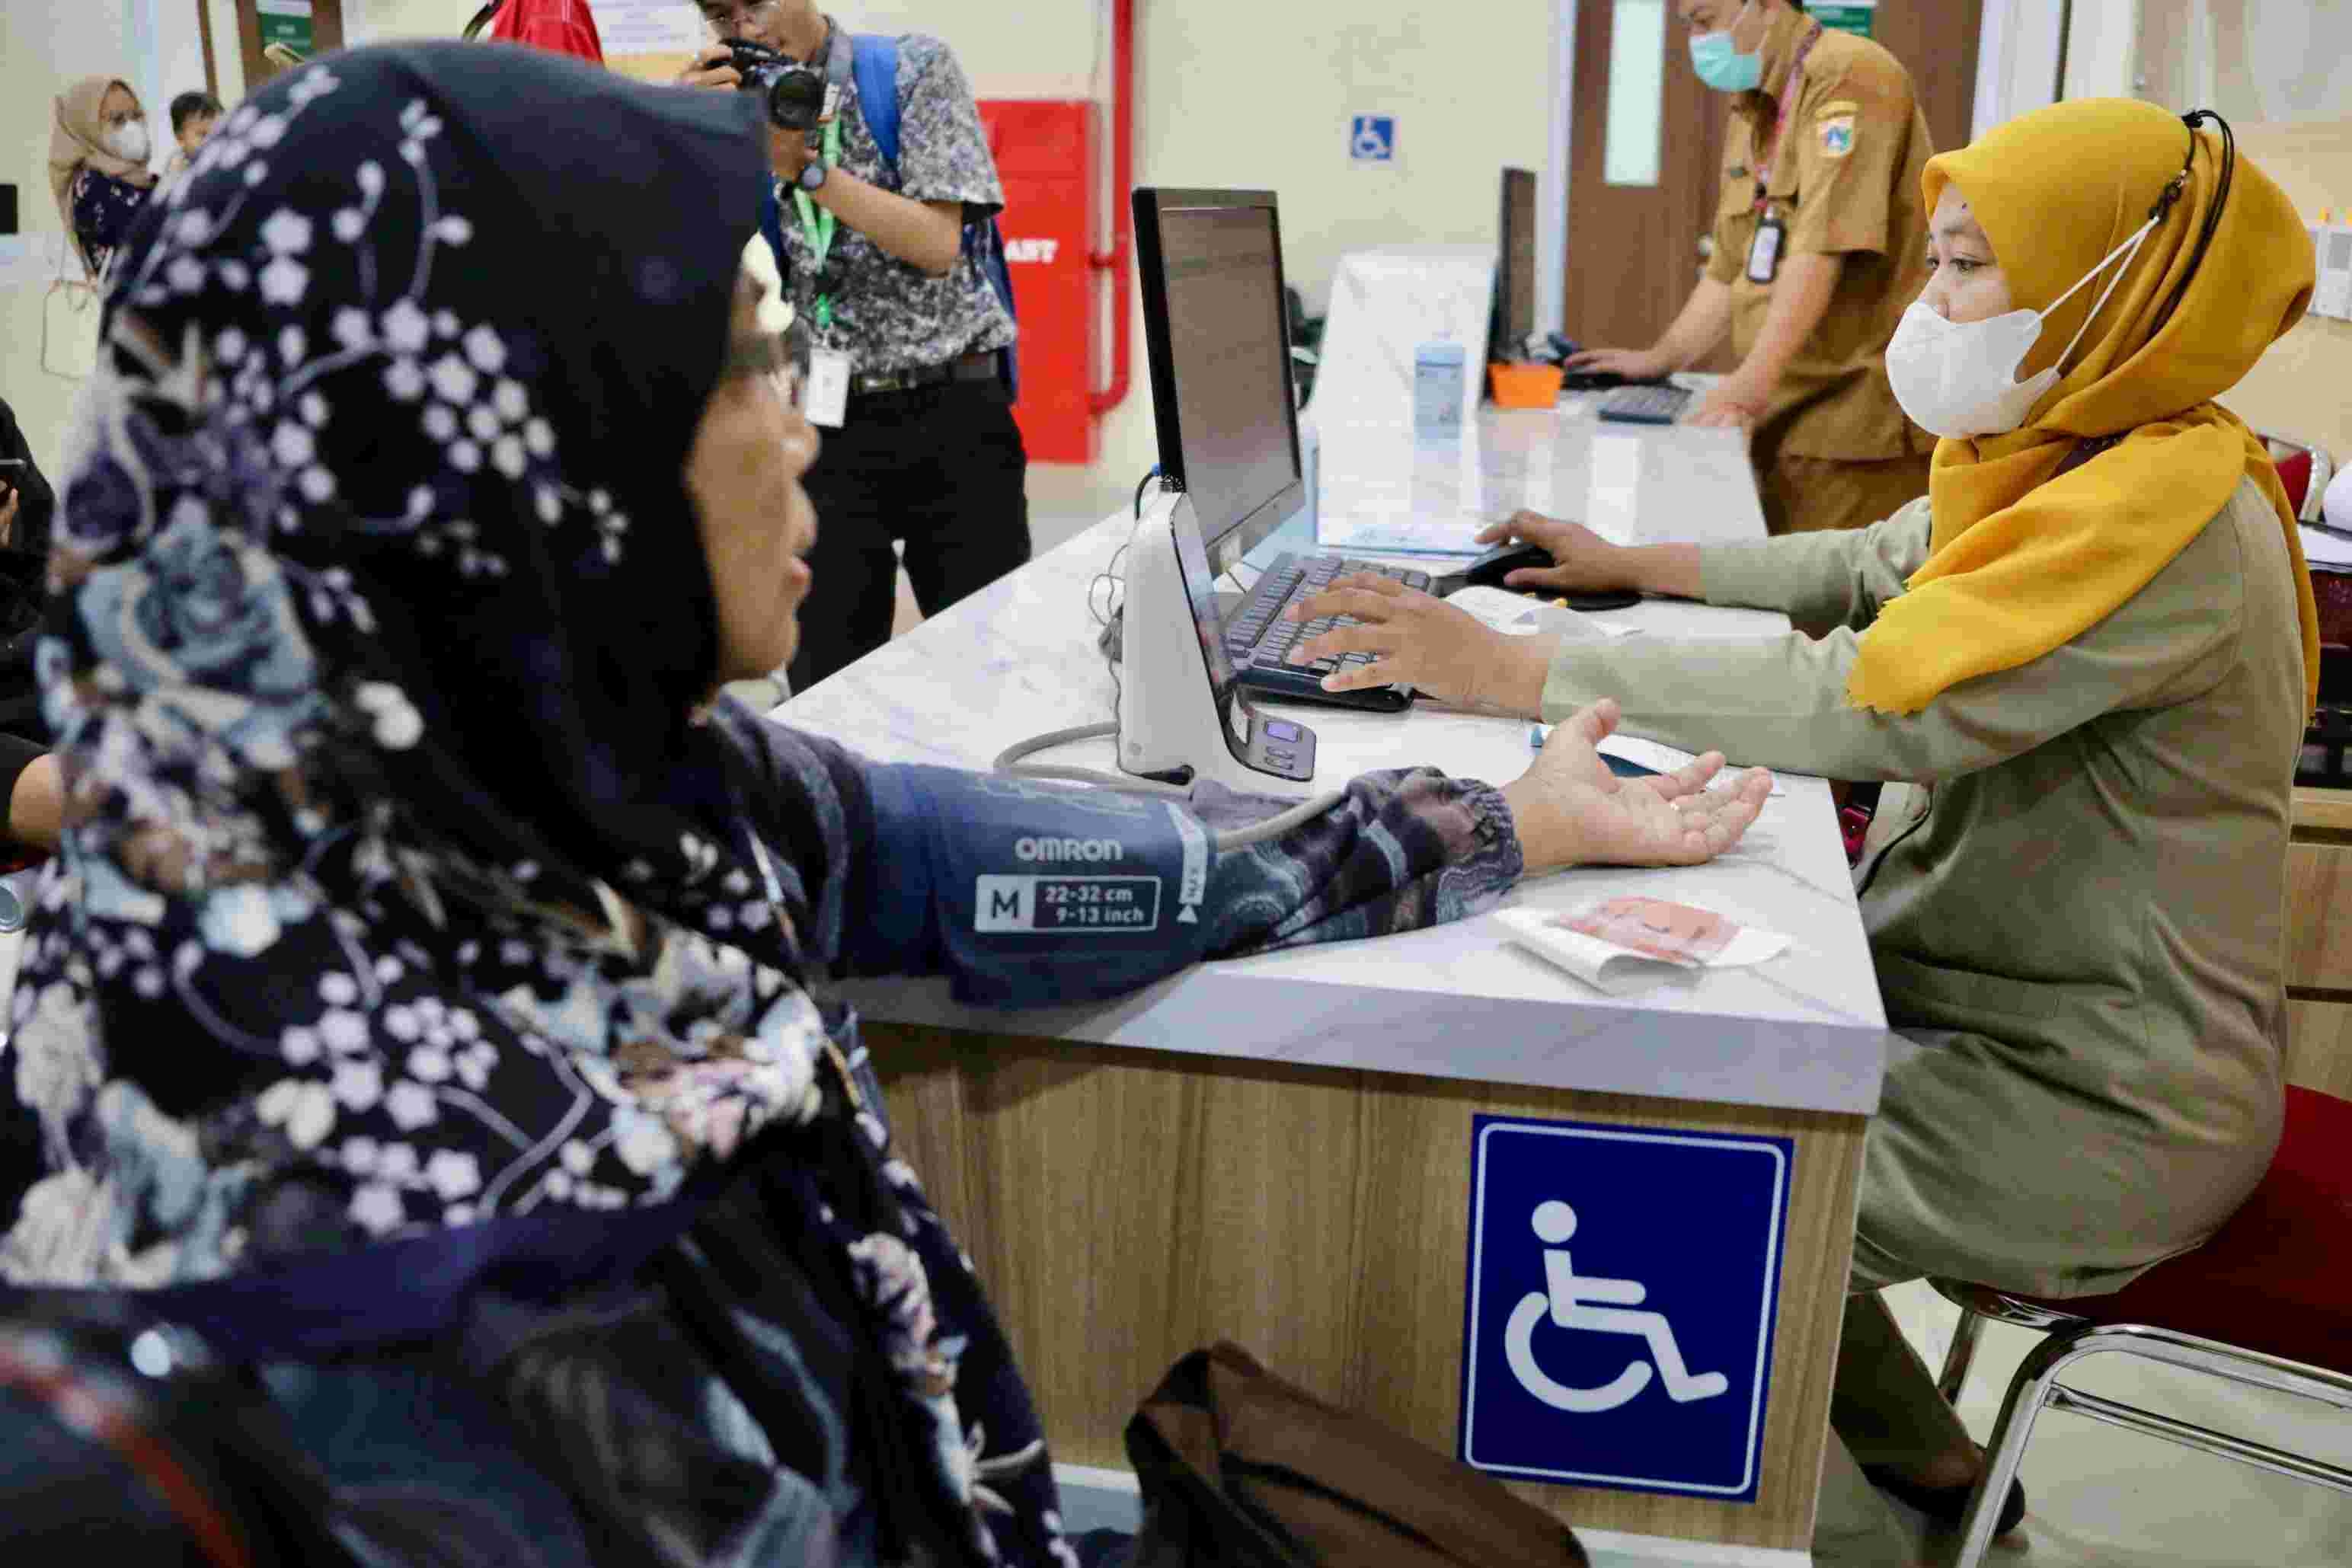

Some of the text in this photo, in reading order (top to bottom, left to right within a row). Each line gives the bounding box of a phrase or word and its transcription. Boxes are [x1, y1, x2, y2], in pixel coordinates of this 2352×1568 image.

[1045, 885, 1133, 903] 22-32 cm
[992, 889, 1019, 919] M
[1056, 906, 1145, 924] 9-13 inch
